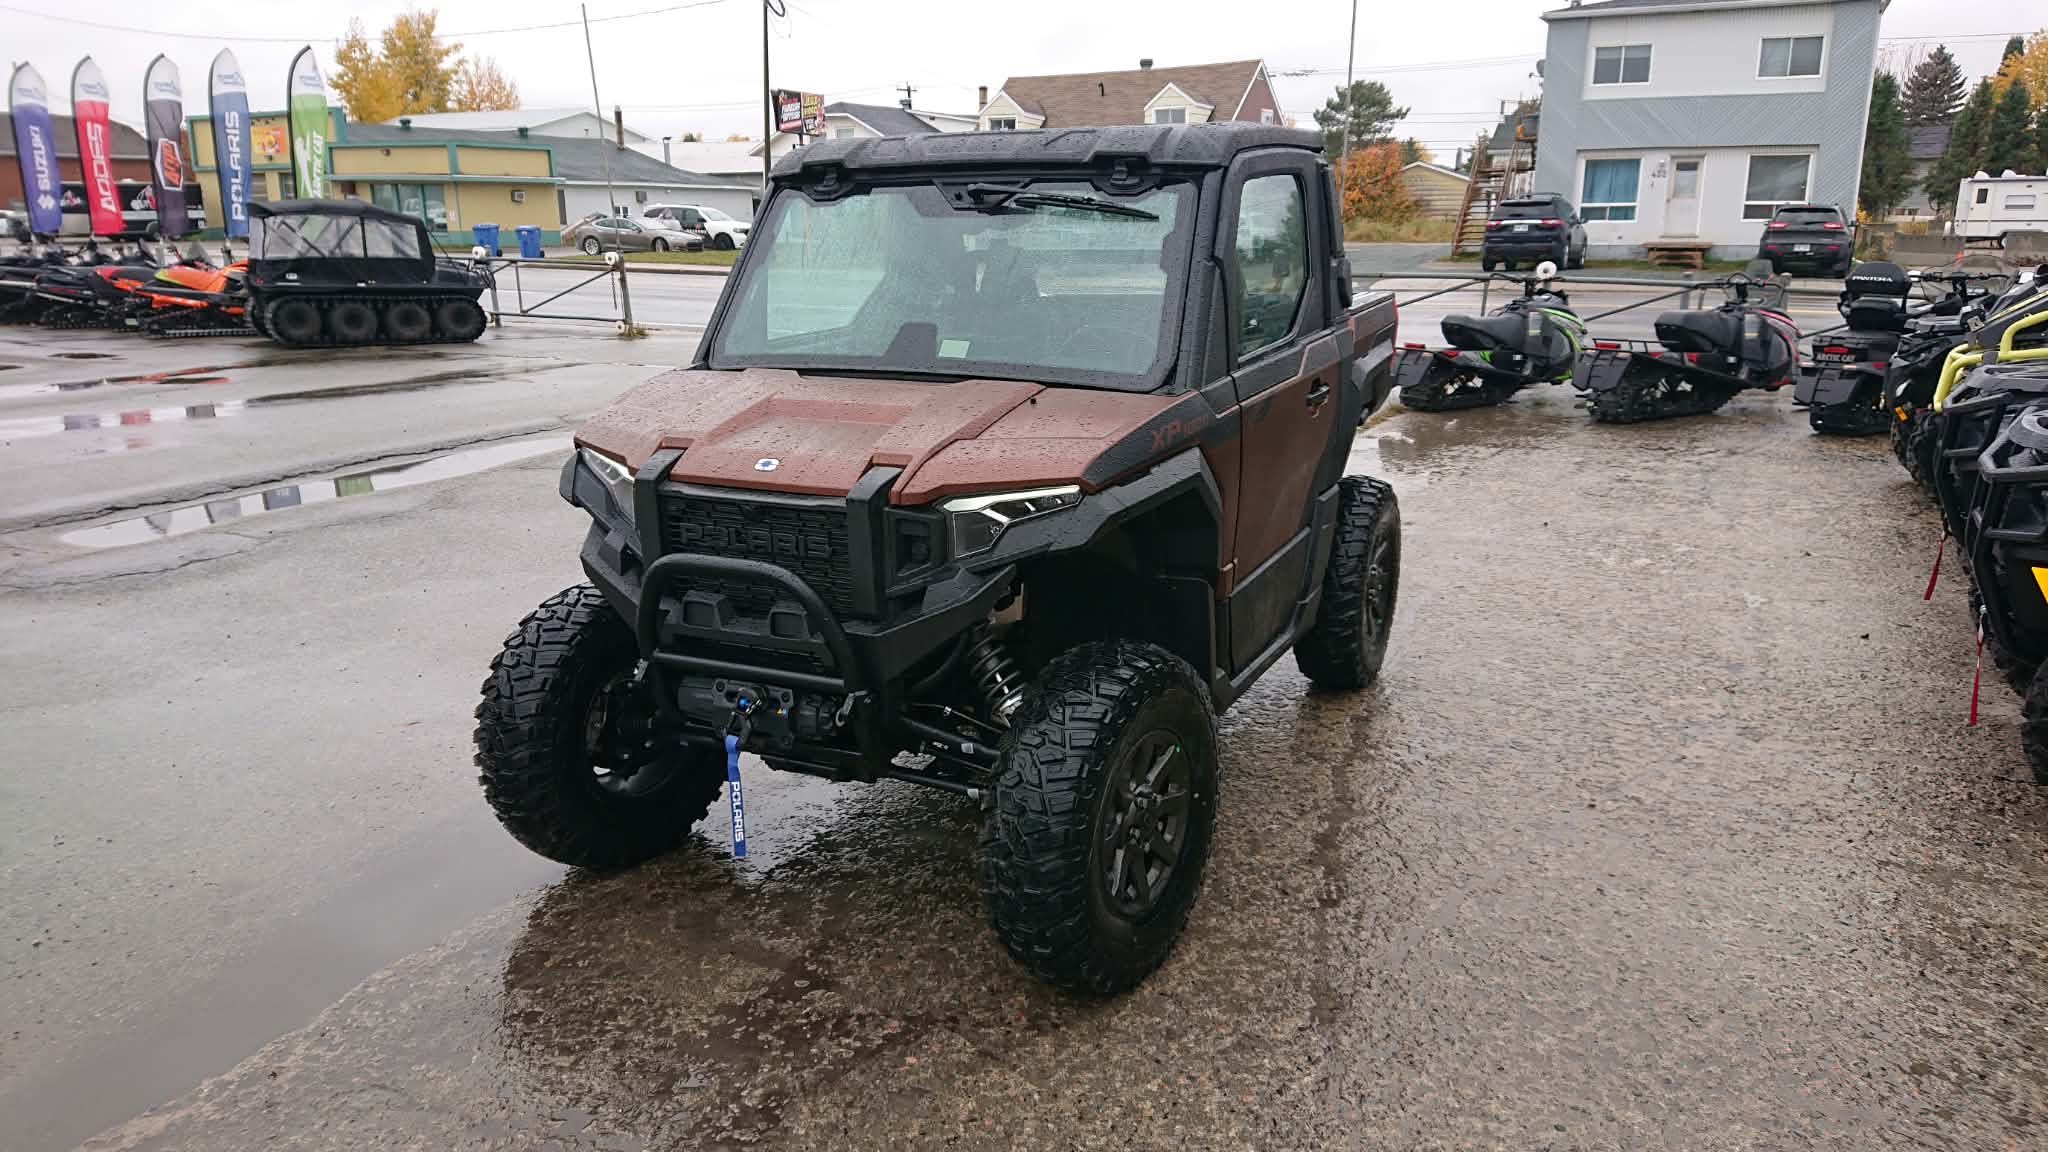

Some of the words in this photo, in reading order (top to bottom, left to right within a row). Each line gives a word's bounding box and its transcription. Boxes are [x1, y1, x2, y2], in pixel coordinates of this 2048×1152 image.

[28, 124, 52, 192] SUZUKI
[224, 111, 245, 221] POLARIS
[1815, 352, 1841, 363] ARCTIC
[1841, 354, 1857, 363] CAT
[1151, 418, 1182, 450] XP
[679, 522, 833, 560] POLARIS
[731, 780, 744, 843] POLARIS
